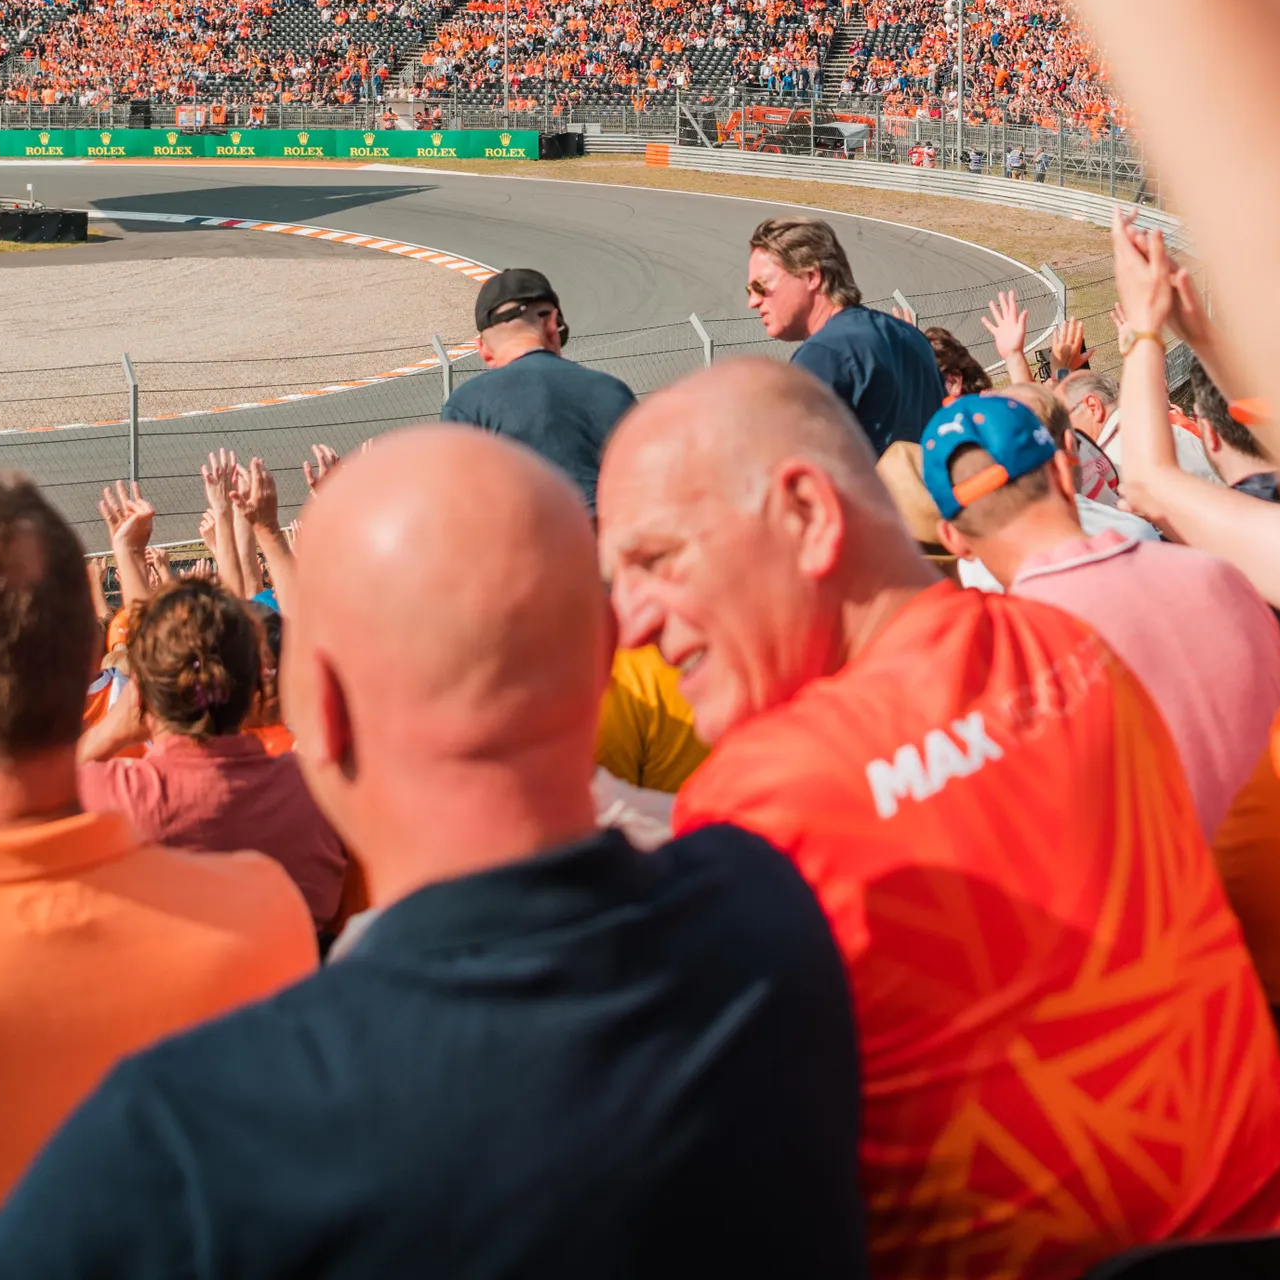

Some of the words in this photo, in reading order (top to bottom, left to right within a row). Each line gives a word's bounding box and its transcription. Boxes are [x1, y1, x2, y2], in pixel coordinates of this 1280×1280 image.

[25, 146, 64, 156] ROLEX
[88, 146, 126, 156] ROLEX
[153, 146, 193, 156] ROLEX
[216, 146, 256, 156] ROLEX
[283, 146, 323, 156] ROLEX
[349, 147, 390, 157] ROLEX
[417, 147, 457, 157] ROLEX
[484, 148, 526, 158] ROLEX
[866, 710, 1004, 820] MAX
